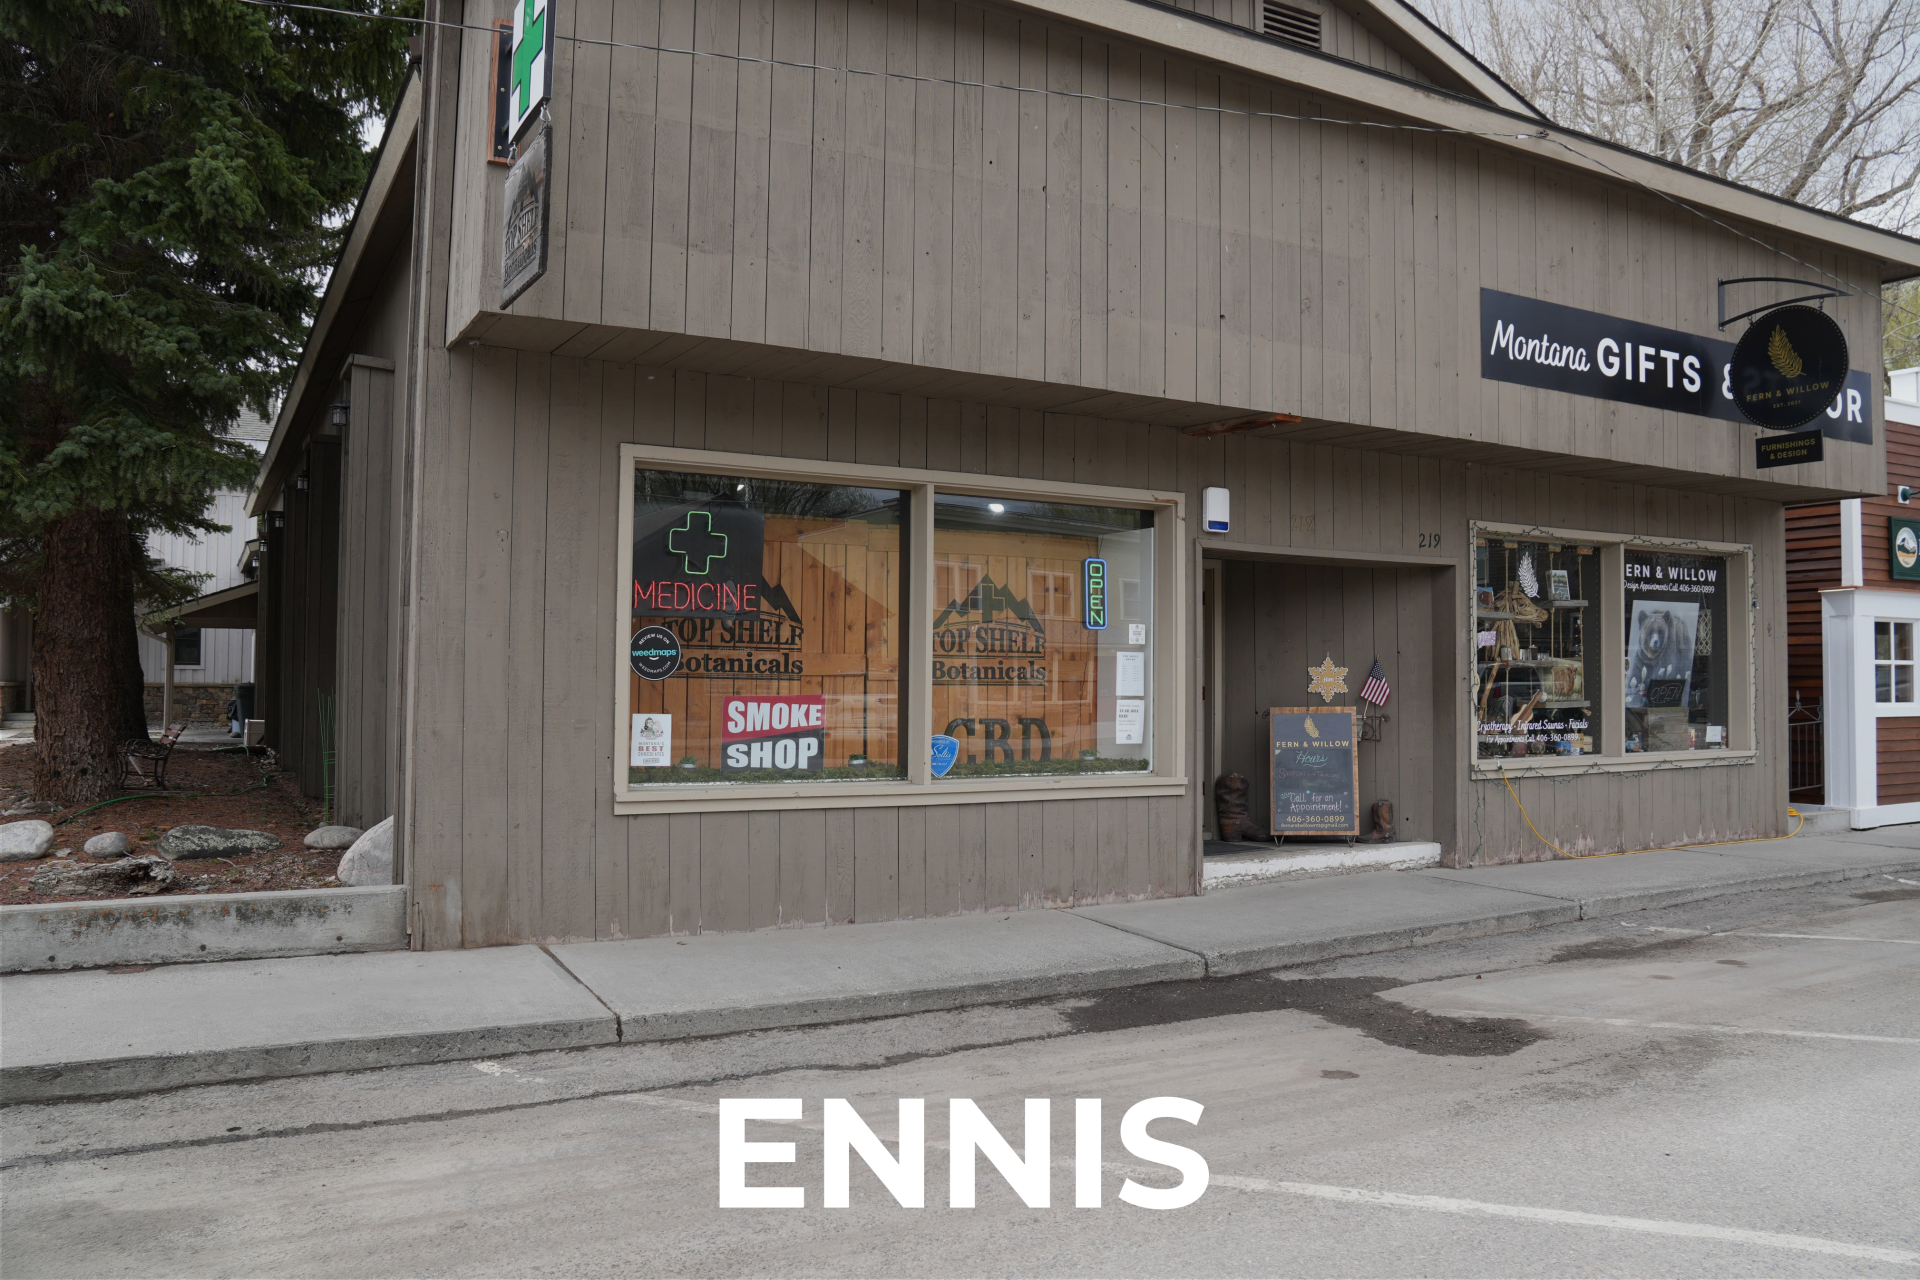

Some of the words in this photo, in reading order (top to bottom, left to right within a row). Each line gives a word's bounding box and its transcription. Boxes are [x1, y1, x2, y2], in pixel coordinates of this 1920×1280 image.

[1490, 319, 1591, 372] Montana
[1596, 337, 1701, 393] GIFTS
[1746, 391, 1772, 402] FERN
[1786, 381, 1829, 395] WILLOW
[1761, 438, 1816, 452] FURNISHINGS
[1777, 449, 1808, 459] DESIGN
[1419, 533, 1441, 549] 219
[1626, 563, 1651, 578] ERN
[1656, 566, 1663, 579] &
[1668, 567, 1717, 582] WILLOW
[634, 580, 758, 611] MEDICINE
[1089, 563, 1104, 626] OPEN
[1669, 583, 1679, 592] Call
[1679, 584, 1715, 594] 406-360-0899
[638, 633, 656, 645] REVIEW
[663, 637, 670, 645] ON
[720, 619, 804, 646] SHELF
[976, 627, 1047, 654] SHELF
[632, 648, 677, 657] weedmaps
[933, 660, 1047, 680] Botanicals
[1651, 686, 1681, 700] OPEN
[727, 700, 822, 734] SMOKE
[1518, 720, 1543, 734] Infrared
[1569, 718, 1589, 729] Facials
[1495, 735, 1525, 745] Appointments
[1526, 735, 1536, 743] Call
[1536, 734, 1579, 742] 406-360-0899
[727, 737, 819, 770] SHOP
[1296, 750, 1329, 764] Hours
[1290, 793, 1307, 803] Call
[1311, 793, 1323, 803] for
[1325, 795, 1334, 803] an
[1290, 800, 1342, 813] Appointment!
